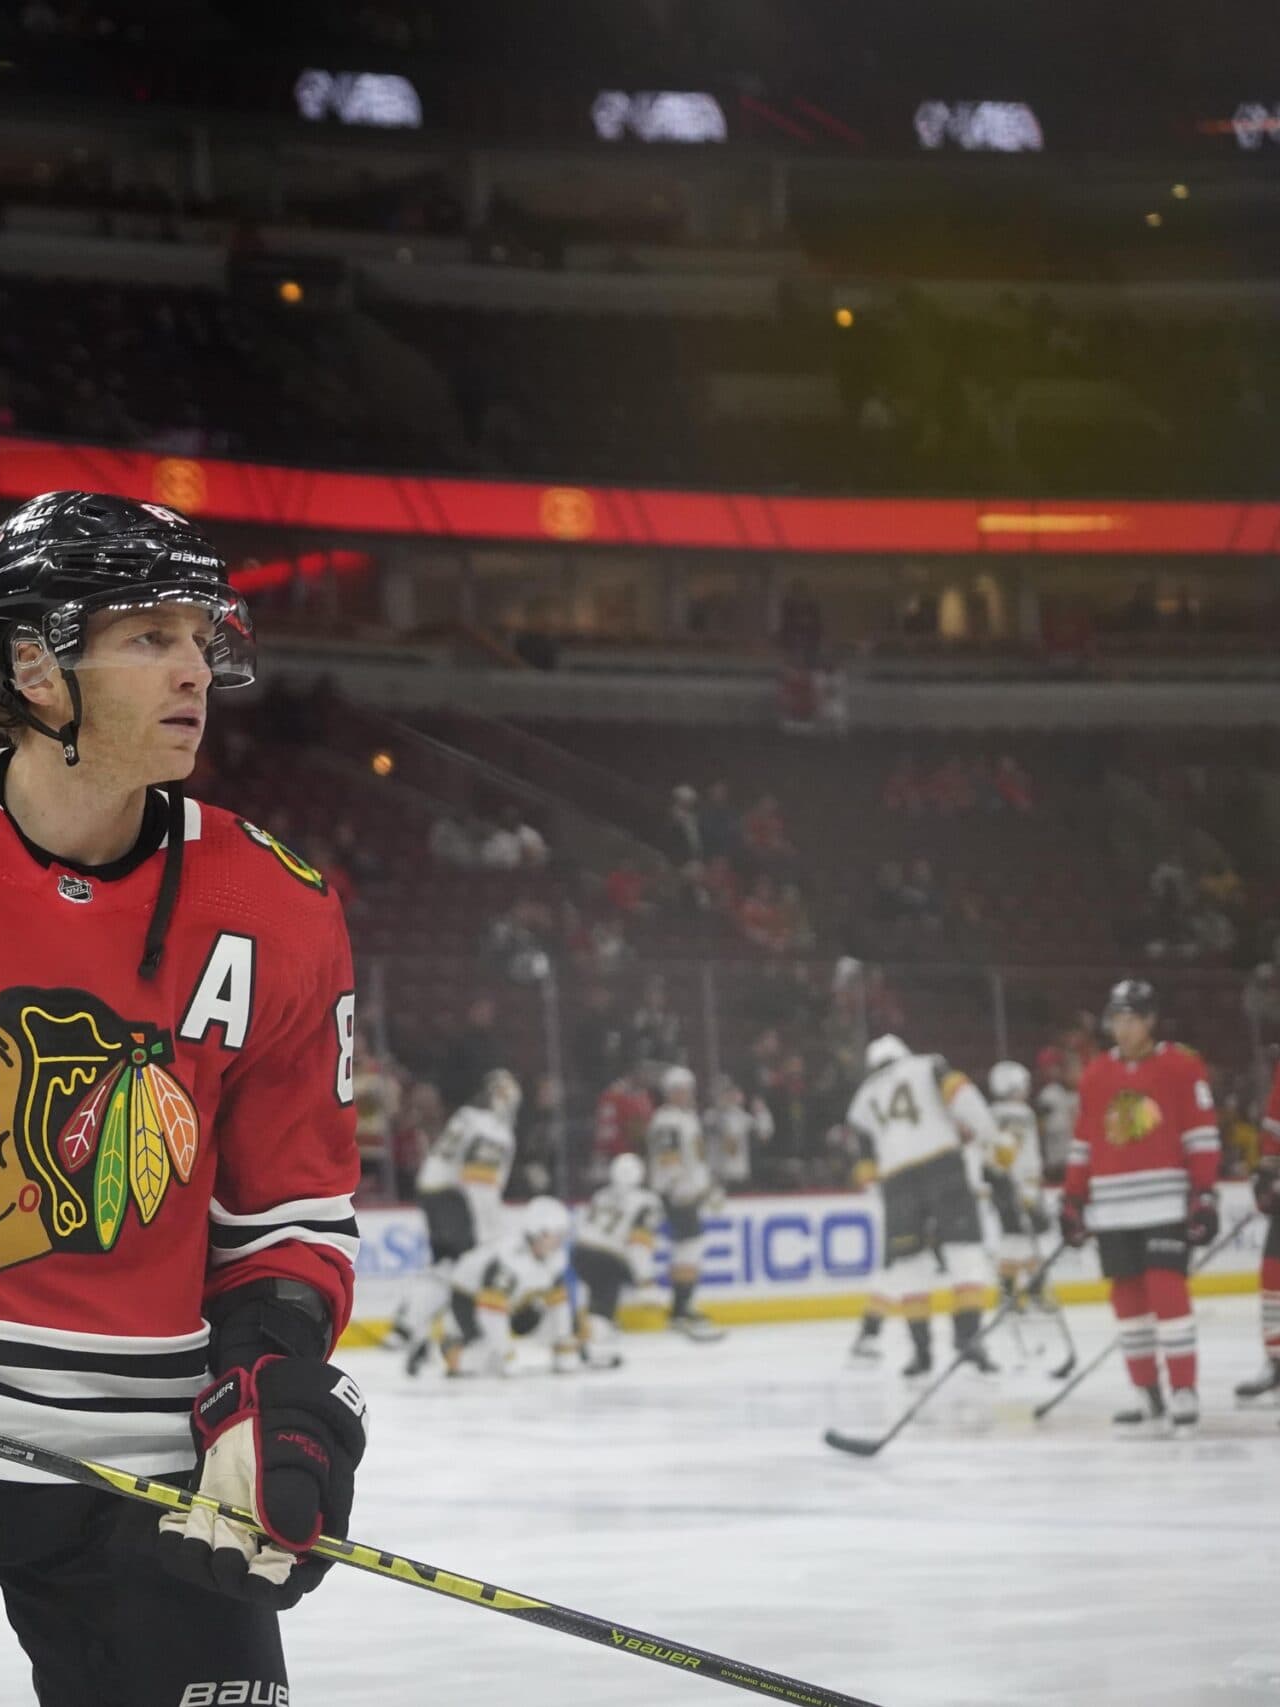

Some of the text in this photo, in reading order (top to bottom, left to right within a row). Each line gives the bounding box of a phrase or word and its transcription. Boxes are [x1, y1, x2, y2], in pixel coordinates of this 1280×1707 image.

[180, 933, 252, 1048] A
[652, 1211, 876, 1289] EICO
[624, 1638, 701, 1669] BAUER
[179, 1680, 289, 1707] BAUE
